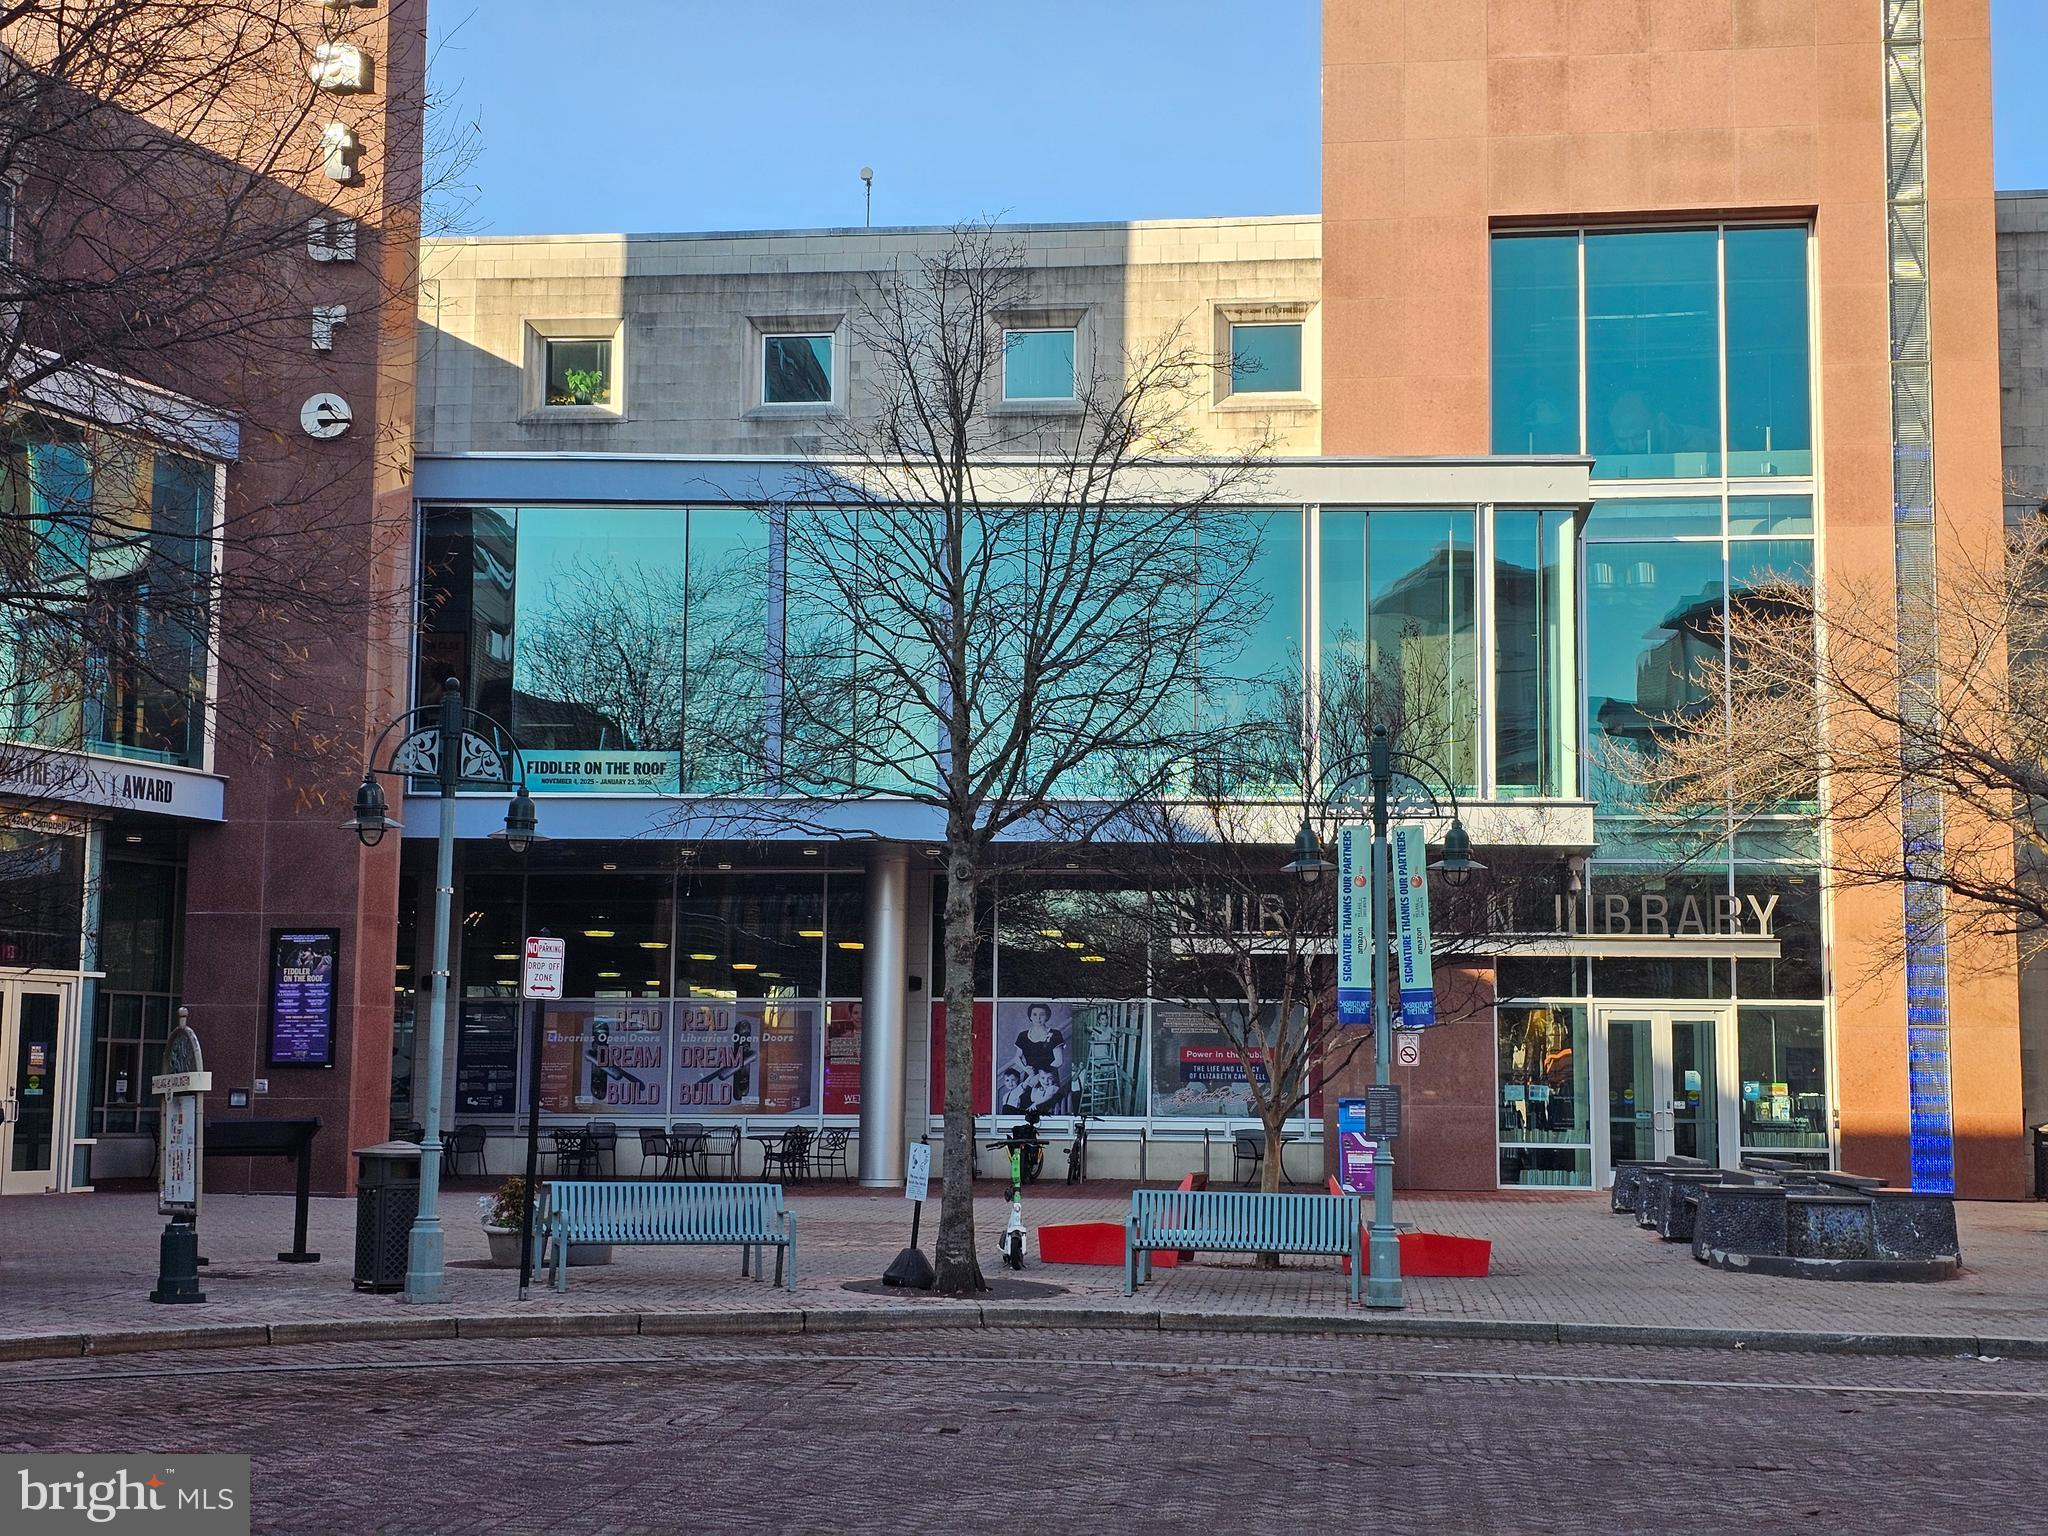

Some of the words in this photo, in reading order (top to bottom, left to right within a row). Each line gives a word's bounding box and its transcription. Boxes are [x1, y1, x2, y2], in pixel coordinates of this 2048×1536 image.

[300, 0, 374, 440] ature
[527, 760, 581, 775] FIDDLER
[584, 761, 602, 775] ON
[605, 761, 631, 776] THE
[633, 761, 668, 776] ROOF
[123, 774, 173, 804] AWARD
[599, 778, 627, 786] JANUARY
[1342, 830, 1352, 874] PARTNERS
[1396, 831, 1408, 875] PARTNERS
[1342, 874, 1352, 894] OUR
[1399, 875, 1409, 895] OUR
[1342, 895, 1352, 932] THANKS
[1400, 896, 1411, 933] THANKS
[1554, 894, 1780, 936] LIBRARY
[527, 942, 538, 954] NO
[538, 945, 562, 953] PARKING
[1342, 933, 1352, 982] SIGNATURE
[1402, 934, 1414, 984] SIGNATURE
[283, 967, 311, 976] FIDDLER
[528, 961, 546, 970] DROP
[534, 973, 554, 981] ZONE
[283, 975, 293, 983] ON
[293, 975, 307, 983] THE
[307, 975, 324, 983] ROOF
[615, 1008, 663, 1032] READ
[680, 1008, 729, 1032] READ
[547, 1032, 595, 1043] Libraries
[597, 1033, 629, 1044] Open
[629, 1033, 661, 1043] Doors
[680, 1033, 728, 1043] Libraries
[731, 1032, 759, 1044] Open
[762, 1032, 795, 1042] Doors
[596, 1045, 662, 1068] DREAM
[679, 1045, 745, 1068] DREAM
[1186, 1050, 1213, 1059] Power
[1215, 1050, 1224, 1059] in
[1236, 1065, 1260, 1073] LECY
[607, 1081, 661, 1105] BUILD
[679, 1081, 732, 1106] BUILD
